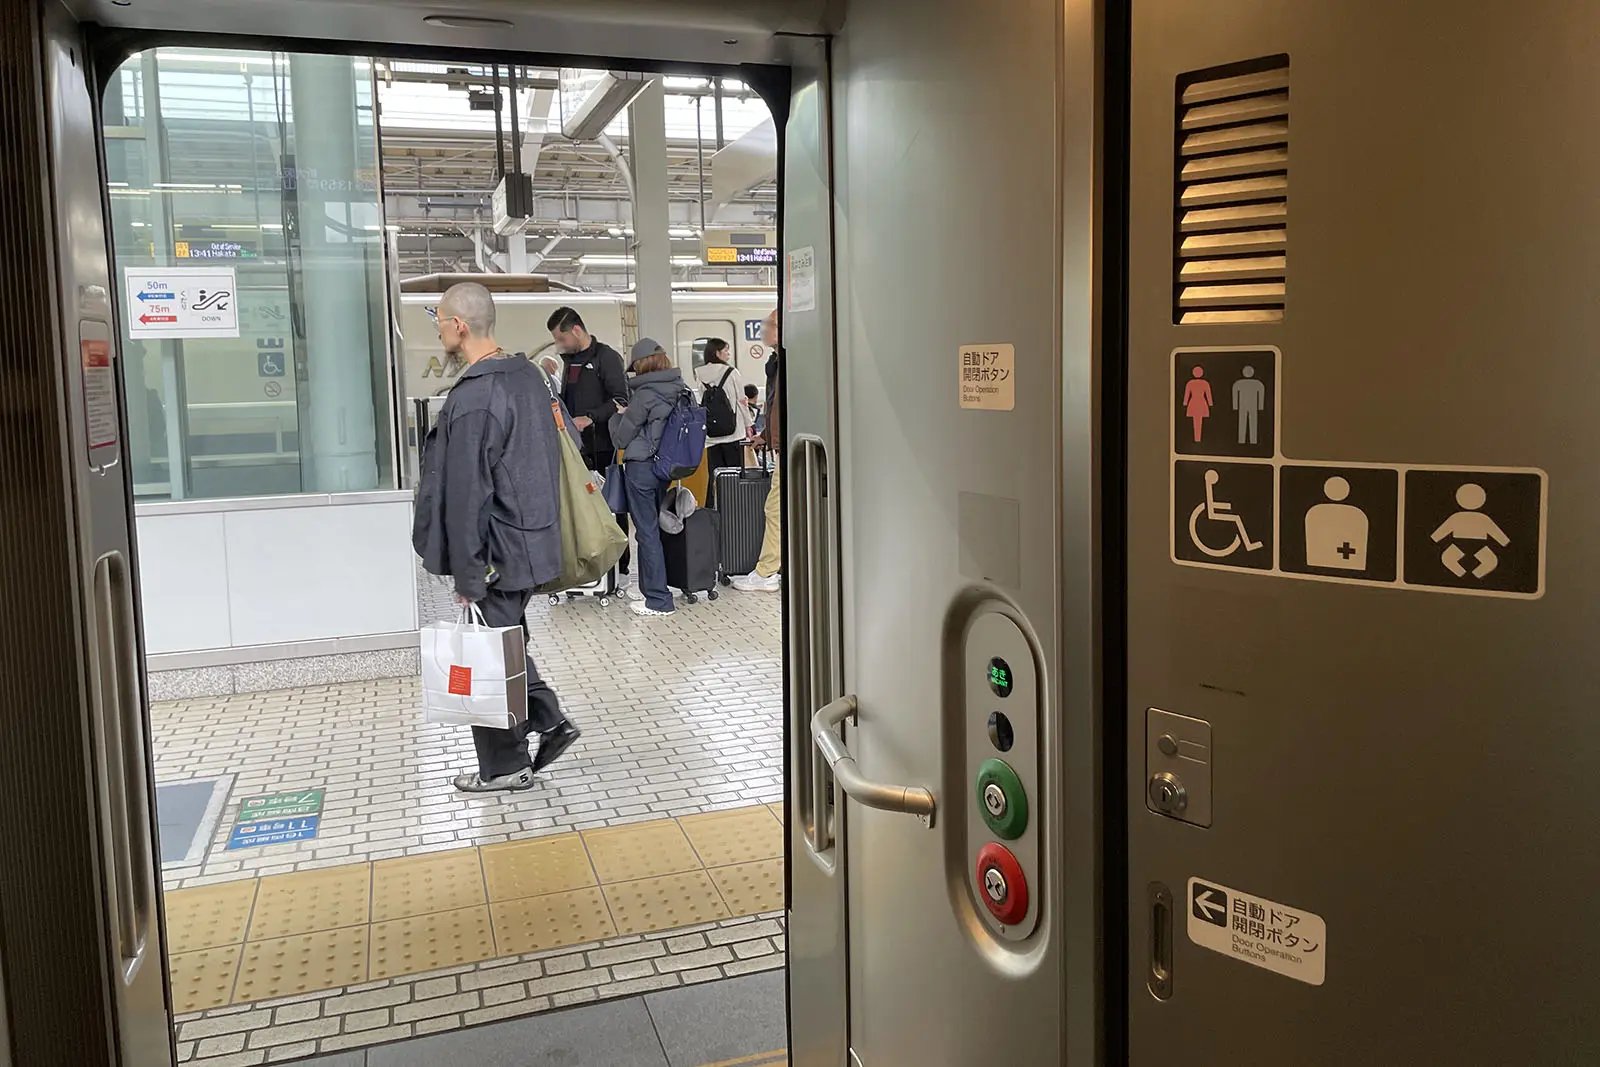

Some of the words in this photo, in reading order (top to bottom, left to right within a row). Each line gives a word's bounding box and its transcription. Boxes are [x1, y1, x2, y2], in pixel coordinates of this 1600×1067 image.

[147, 281, 168, 290] 50m
[149, 305, 170, 313] 75m
[963, 352, 999, 366] 自動ドア
[963, 367, 1010, 382] 開閉ボタン
[963, 385, 974, 393] Door
[975, 385, 999, 394] Operation
[963, 394, 981, 402] Buttons
[991, 666, 1006, 681] あき
[1233, 897, 1300, 929] 自動ドア
[1232, 914, 1319, 953] 開閉ボタン
[1232, 934, 1254, 948] Door
[1256, 942, 1303, 965] Operation
[1232, 943, 1266, 963] Buttons
